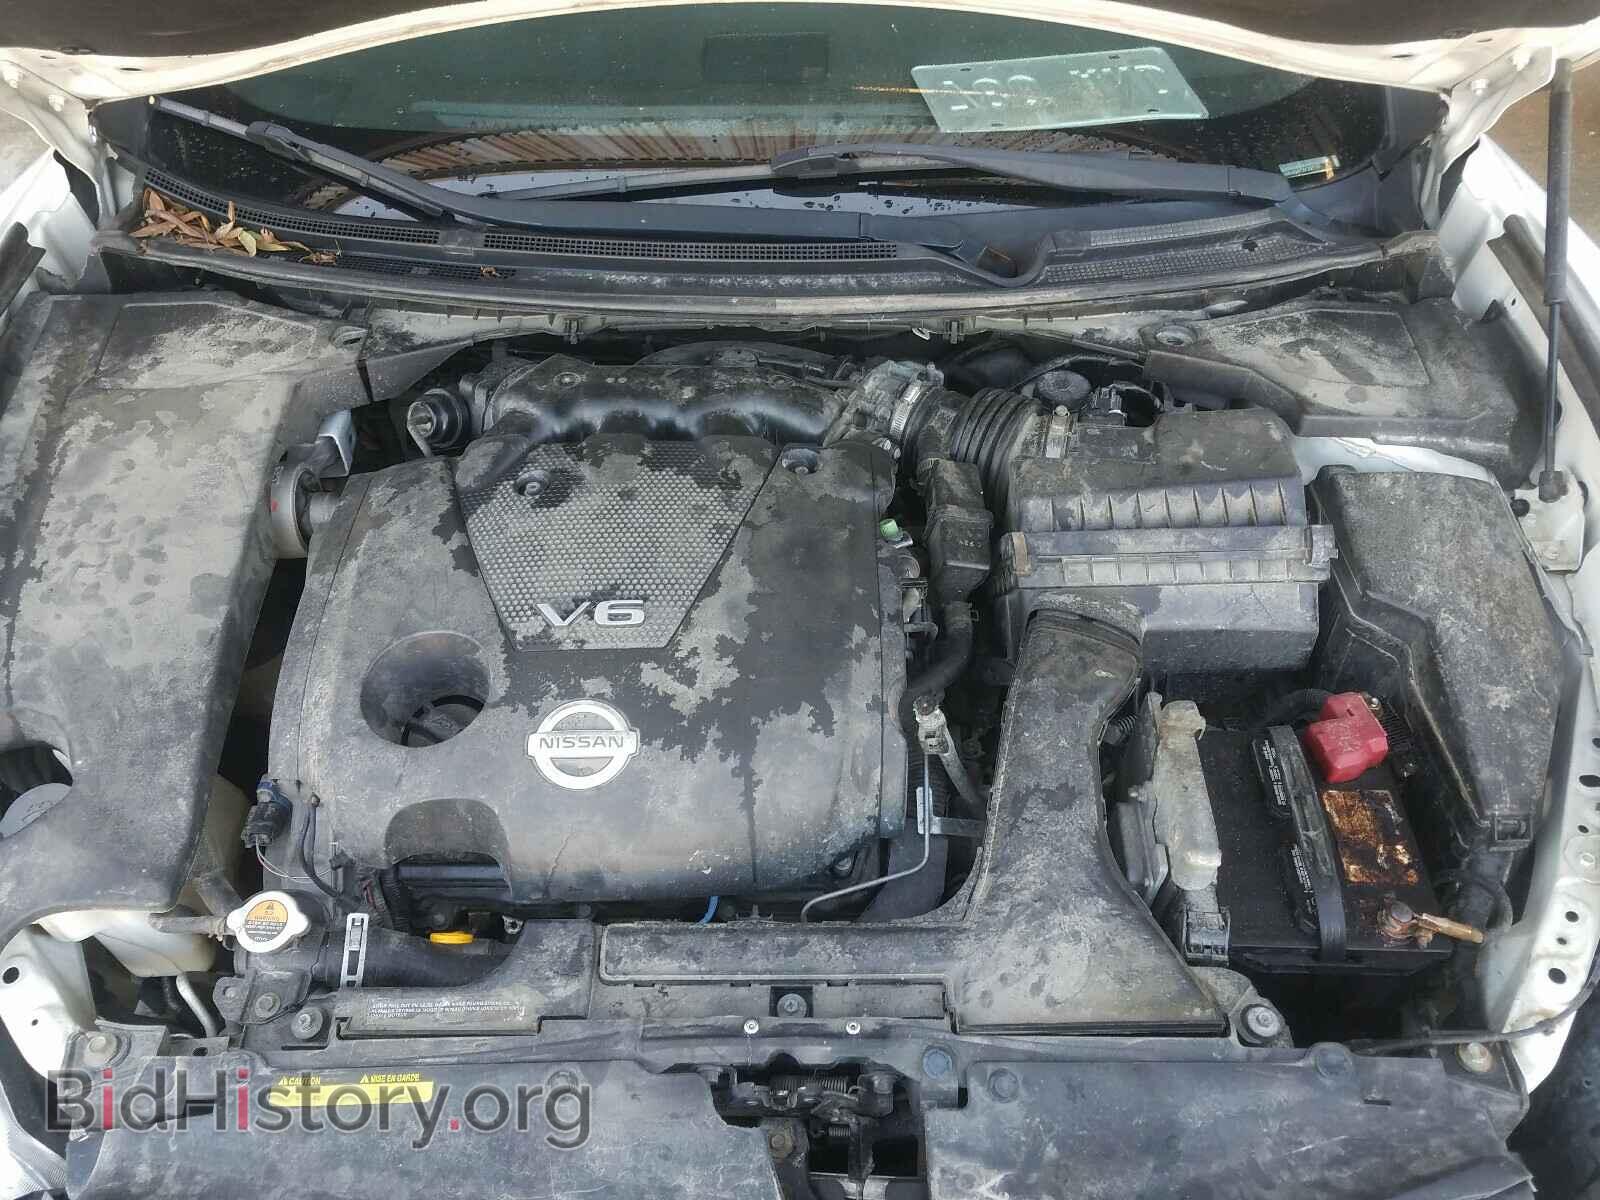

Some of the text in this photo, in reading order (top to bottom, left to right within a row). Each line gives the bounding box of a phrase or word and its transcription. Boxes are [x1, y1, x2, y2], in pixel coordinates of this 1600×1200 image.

[536, 599, 645, 627] V6
[539, 735, 624, 750] NISSAN
[288, 1076, 320, 1086] CAUTION
[386, 1074, 395, 1083] EN
